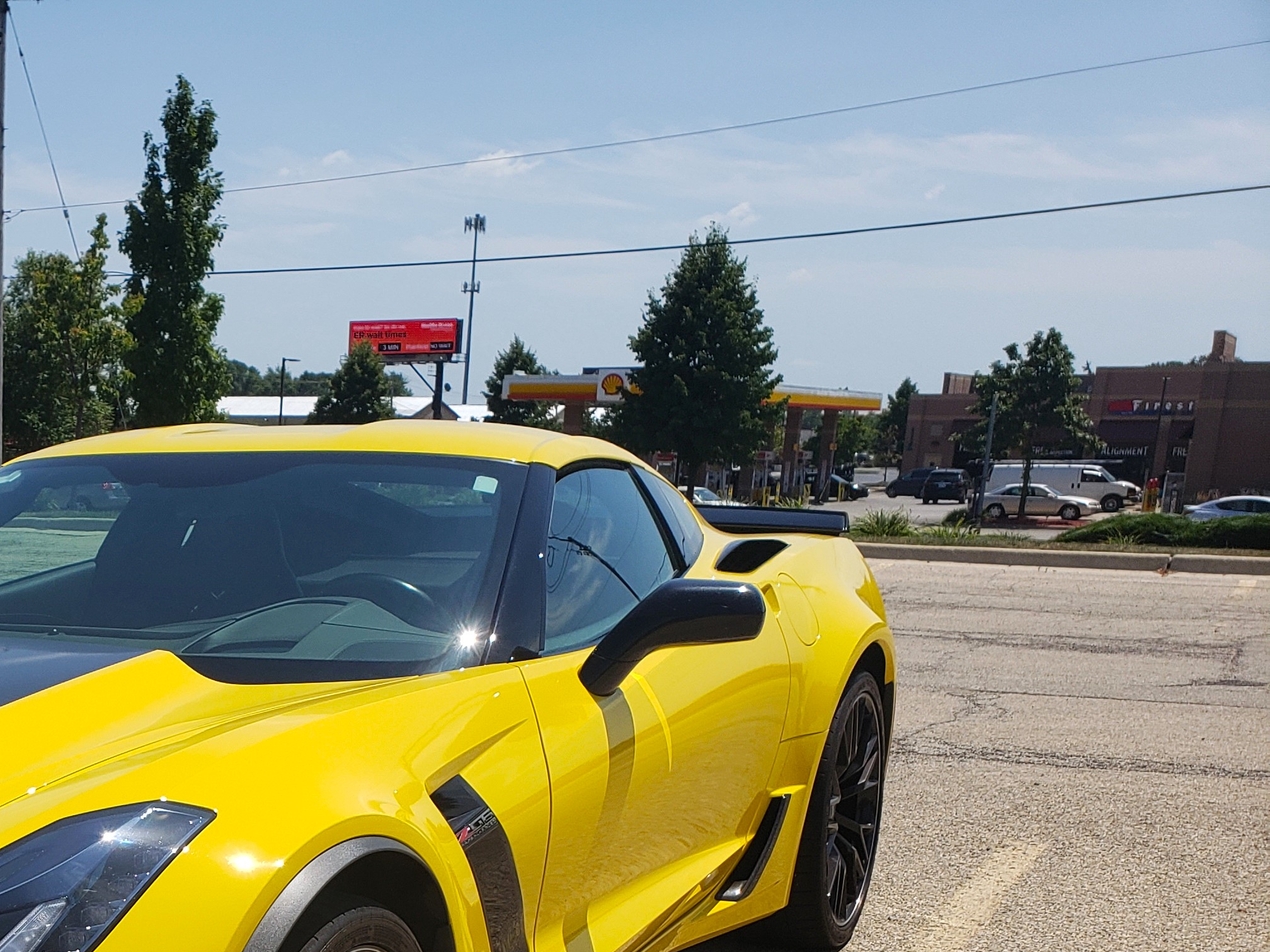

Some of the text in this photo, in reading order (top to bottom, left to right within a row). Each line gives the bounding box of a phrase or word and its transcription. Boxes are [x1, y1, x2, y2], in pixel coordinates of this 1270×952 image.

[367, 330, 383, 339] wait
[385, 330, 407, 338] times
[1100, 446, 1149, 456] ALIGNMENT
